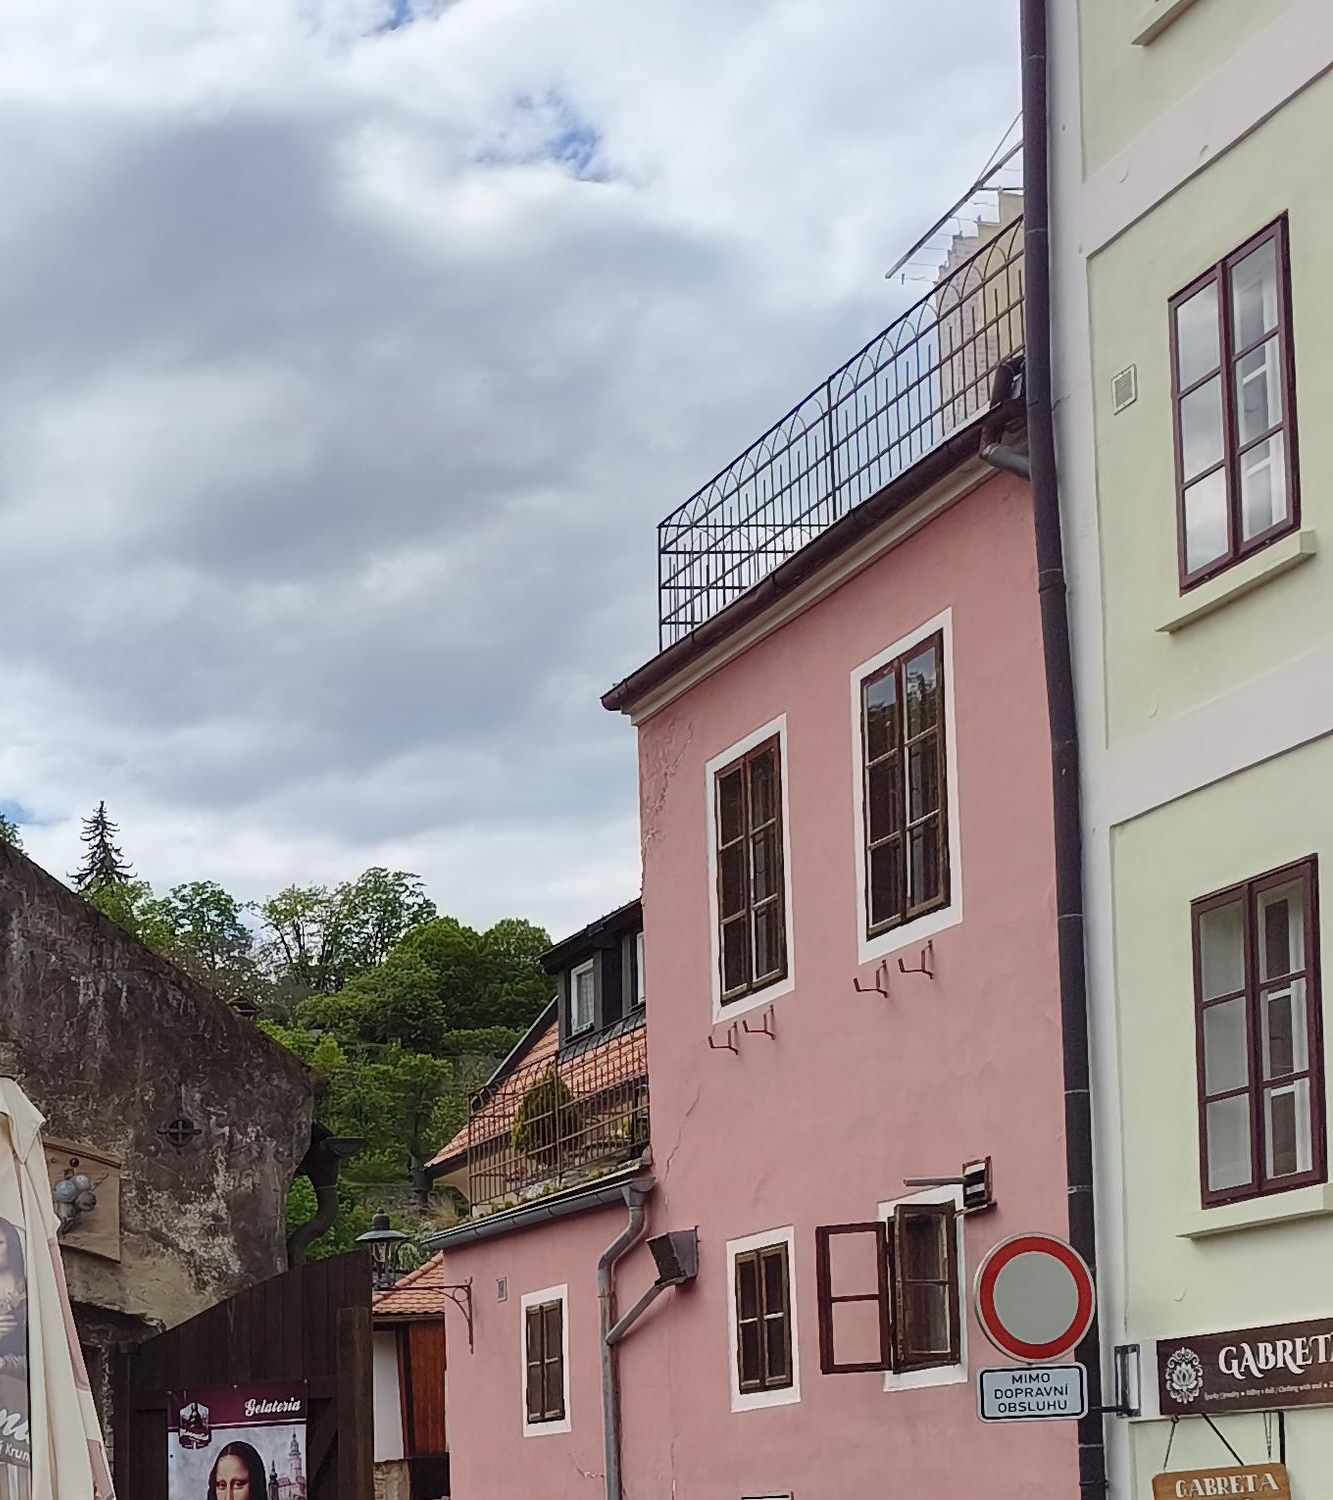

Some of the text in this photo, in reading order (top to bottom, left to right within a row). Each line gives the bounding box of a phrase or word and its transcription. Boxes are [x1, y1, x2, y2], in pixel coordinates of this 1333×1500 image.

[1218, 1332, 1333, 1379] GABRET
[1012, 1373, 1050, 1384] MIMO
[994, 1383, 1069, 1399] DOPRAVNÍ
[244, 1397, 301, 1416] Gelateria
[998, 1400, 1067, 1413] OBSLUHU
[1175, 1473, 1279, 1498] GABRETA
